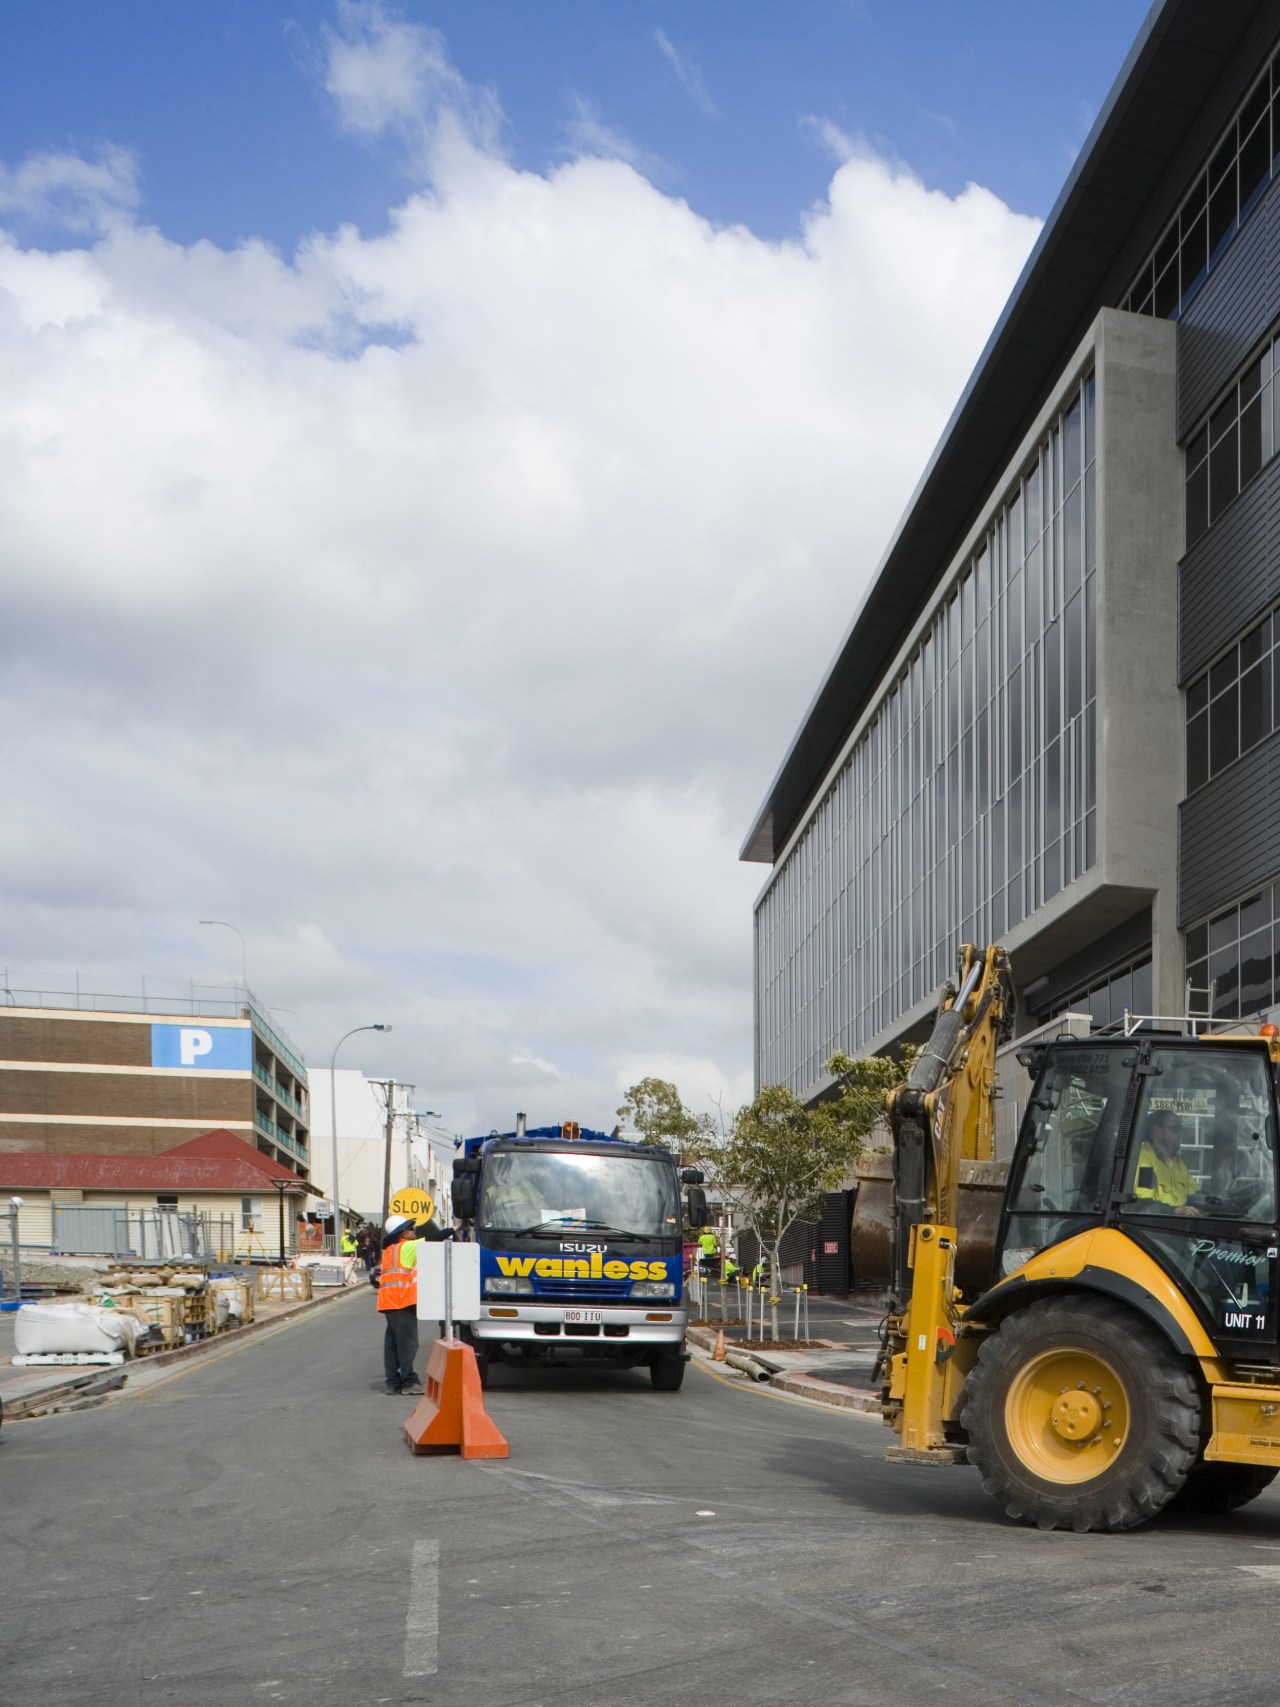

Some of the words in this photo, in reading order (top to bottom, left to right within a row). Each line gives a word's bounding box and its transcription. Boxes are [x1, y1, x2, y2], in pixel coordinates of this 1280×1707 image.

[180, 1029, 213, 1065] P
[1094, 1053, 1110, 1063] 771
[1089, 1064, 1109, 1073] 6120
[934, 1095, 945, 1140] CAT
[392, 1200, 431, 1214] SLOW
[559, 1243, 608, 1253] ISUZU
[1191, 1239, 1267, 1266] Premier
[496, 1252, 667, 1281] wanless
[1225, 1312, 1253, 1328] UNIT
[1255, 1315, 1265, 1330] 11
